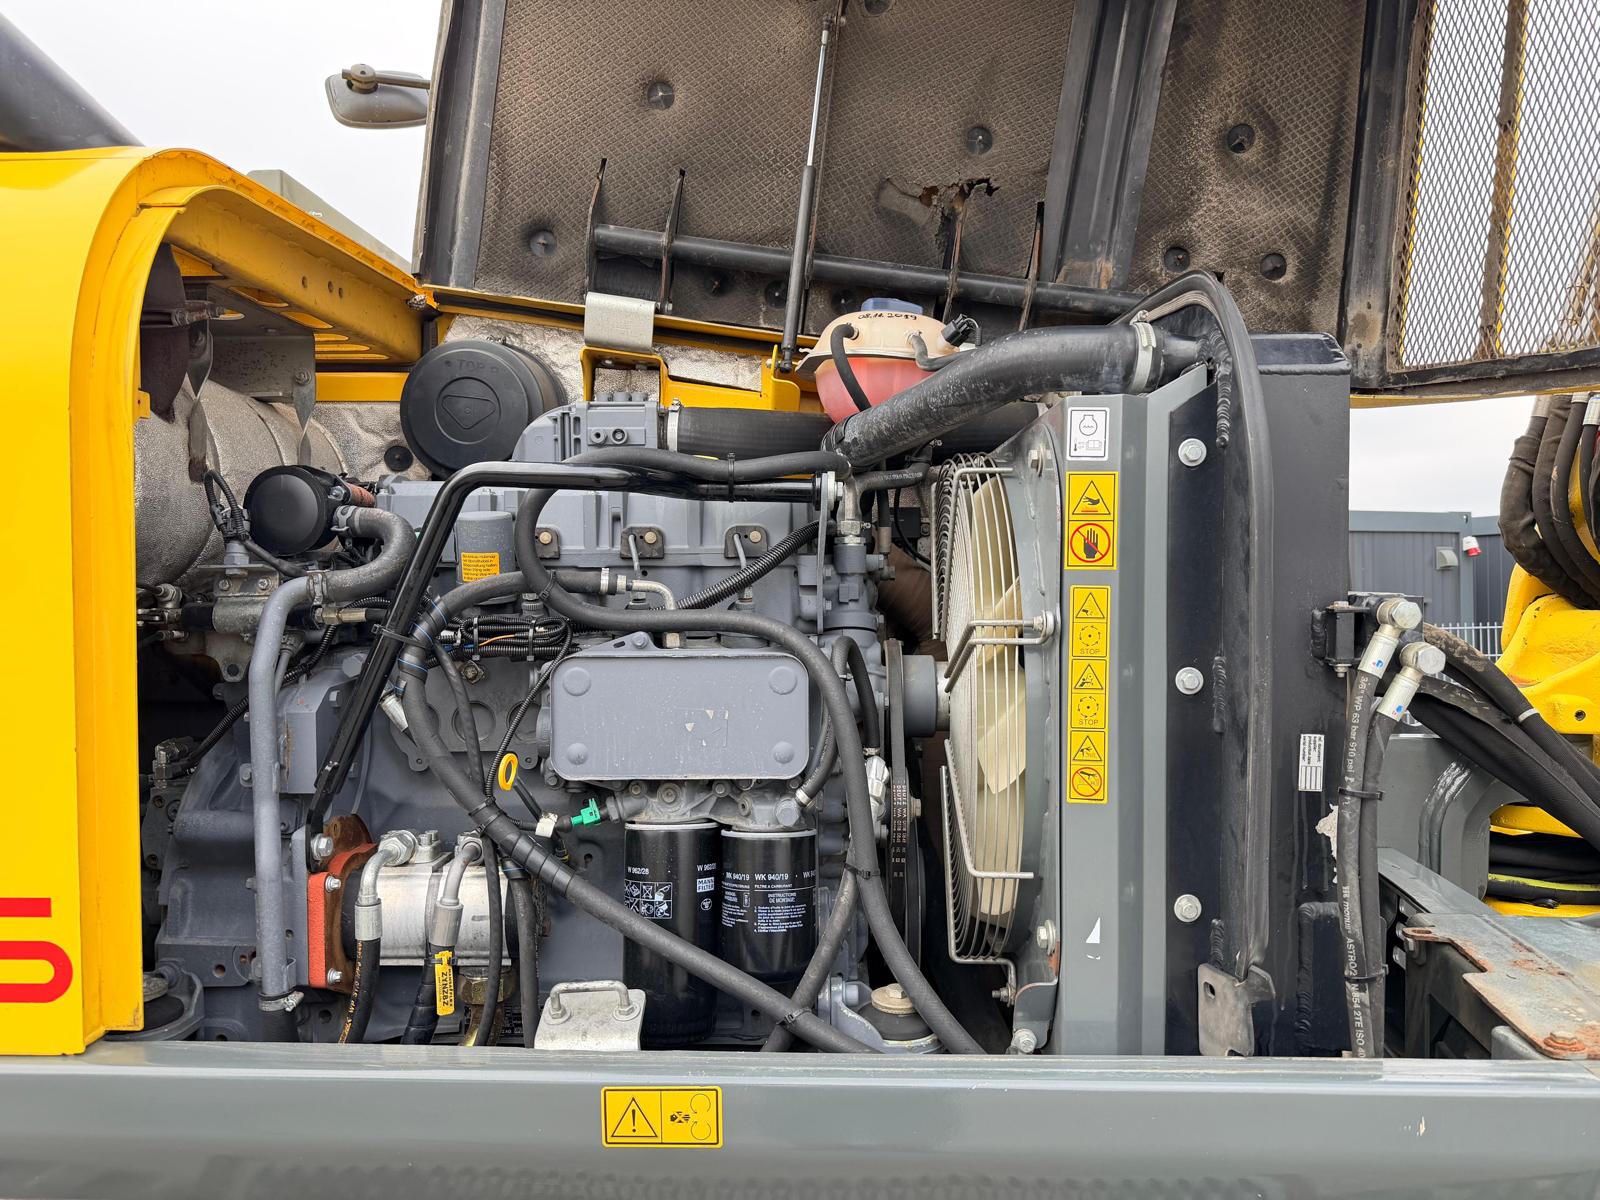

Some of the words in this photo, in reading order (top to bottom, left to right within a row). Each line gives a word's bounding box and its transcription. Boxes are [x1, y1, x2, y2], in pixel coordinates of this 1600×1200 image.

[457, 359, 485, 371] TOP
[1352, 713, 1361, 724] 63
[1350, 726, 1360, 740] bar
[1346, 759, 1355, 773] psi
[696, 864, 704, 872] W
[755, 873, 767, 881] WK
[767, 873, 789, 881] 940/19
[1355, 1029, 1365, 1046] ISO
[1357, 1047, 1367, 1059] 40
